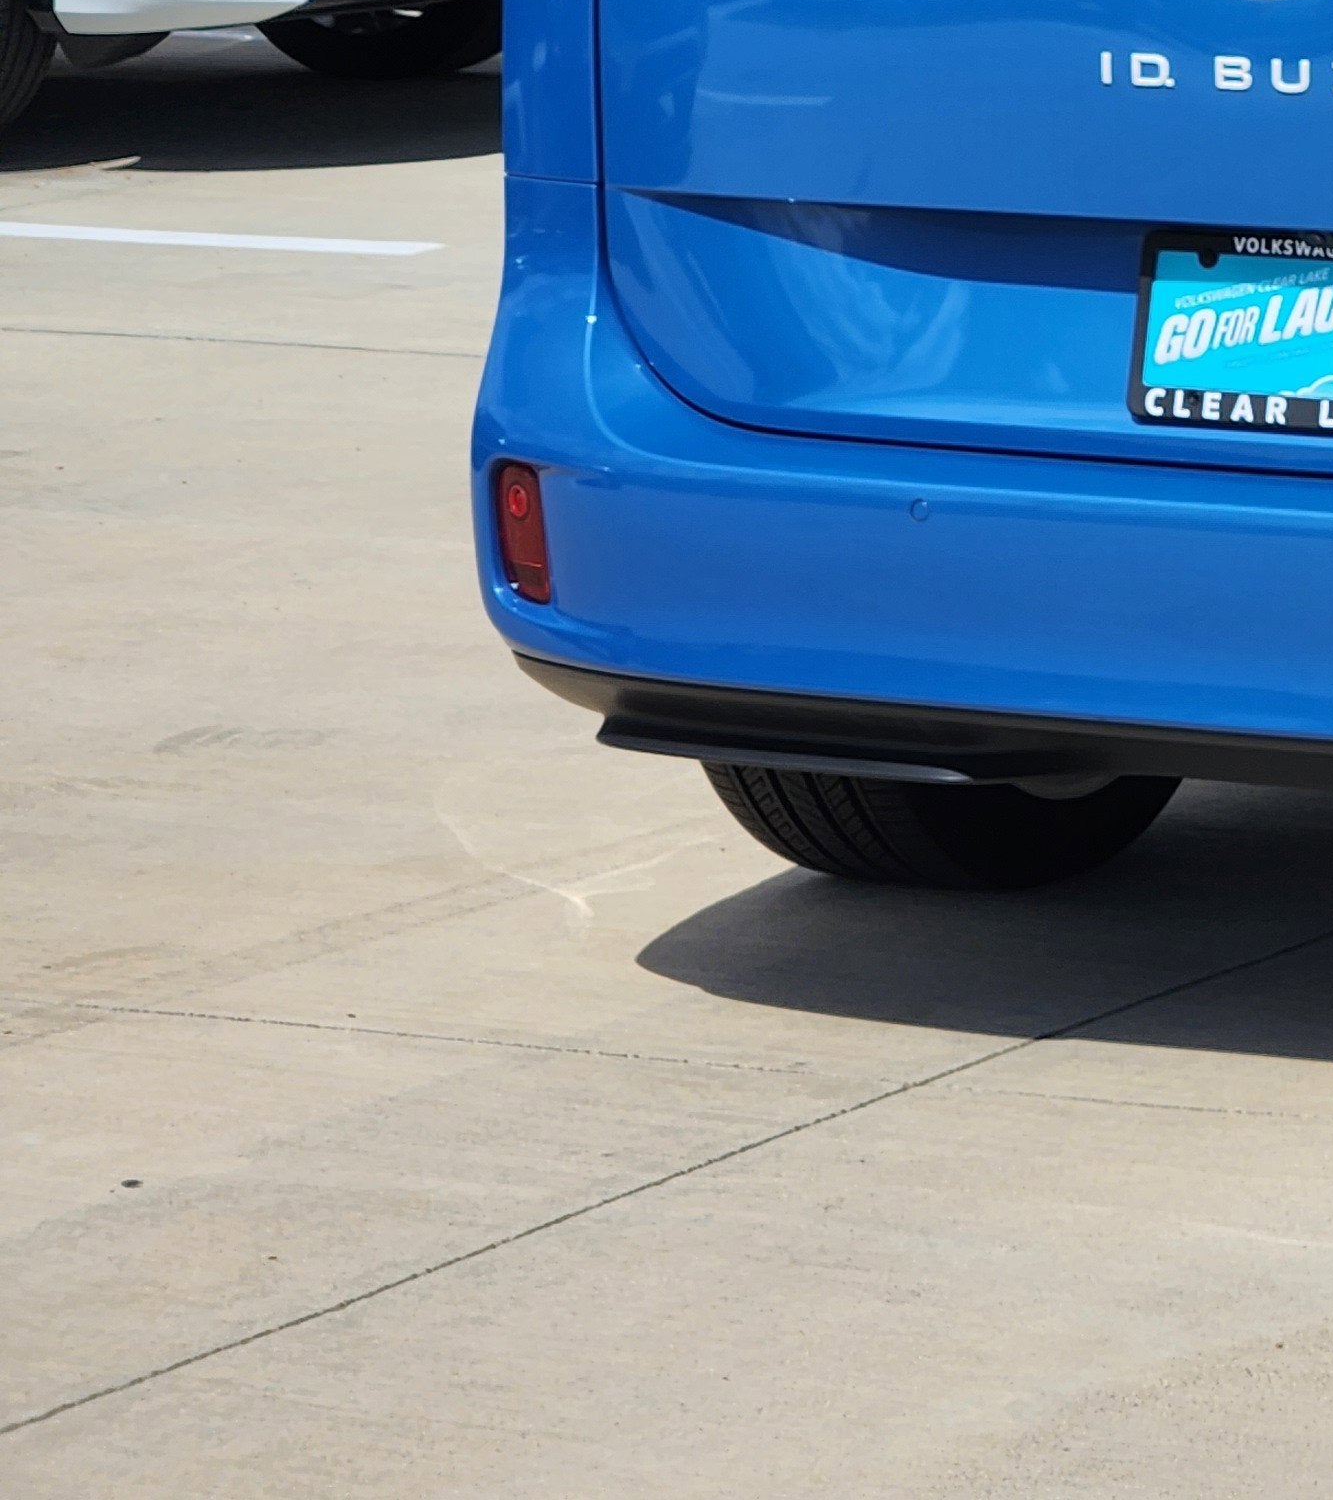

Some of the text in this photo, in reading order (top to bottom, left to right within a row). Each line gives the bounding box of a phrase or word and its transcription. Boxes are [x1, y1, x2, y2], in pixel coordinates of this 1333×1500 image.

[1299, 267, 1331, 285] LAKE
[1154, 311, 1217, 366] GO
[1212, 306, 1261, 350] FOR
[1144, 387, 1289, 426] CLEAR
